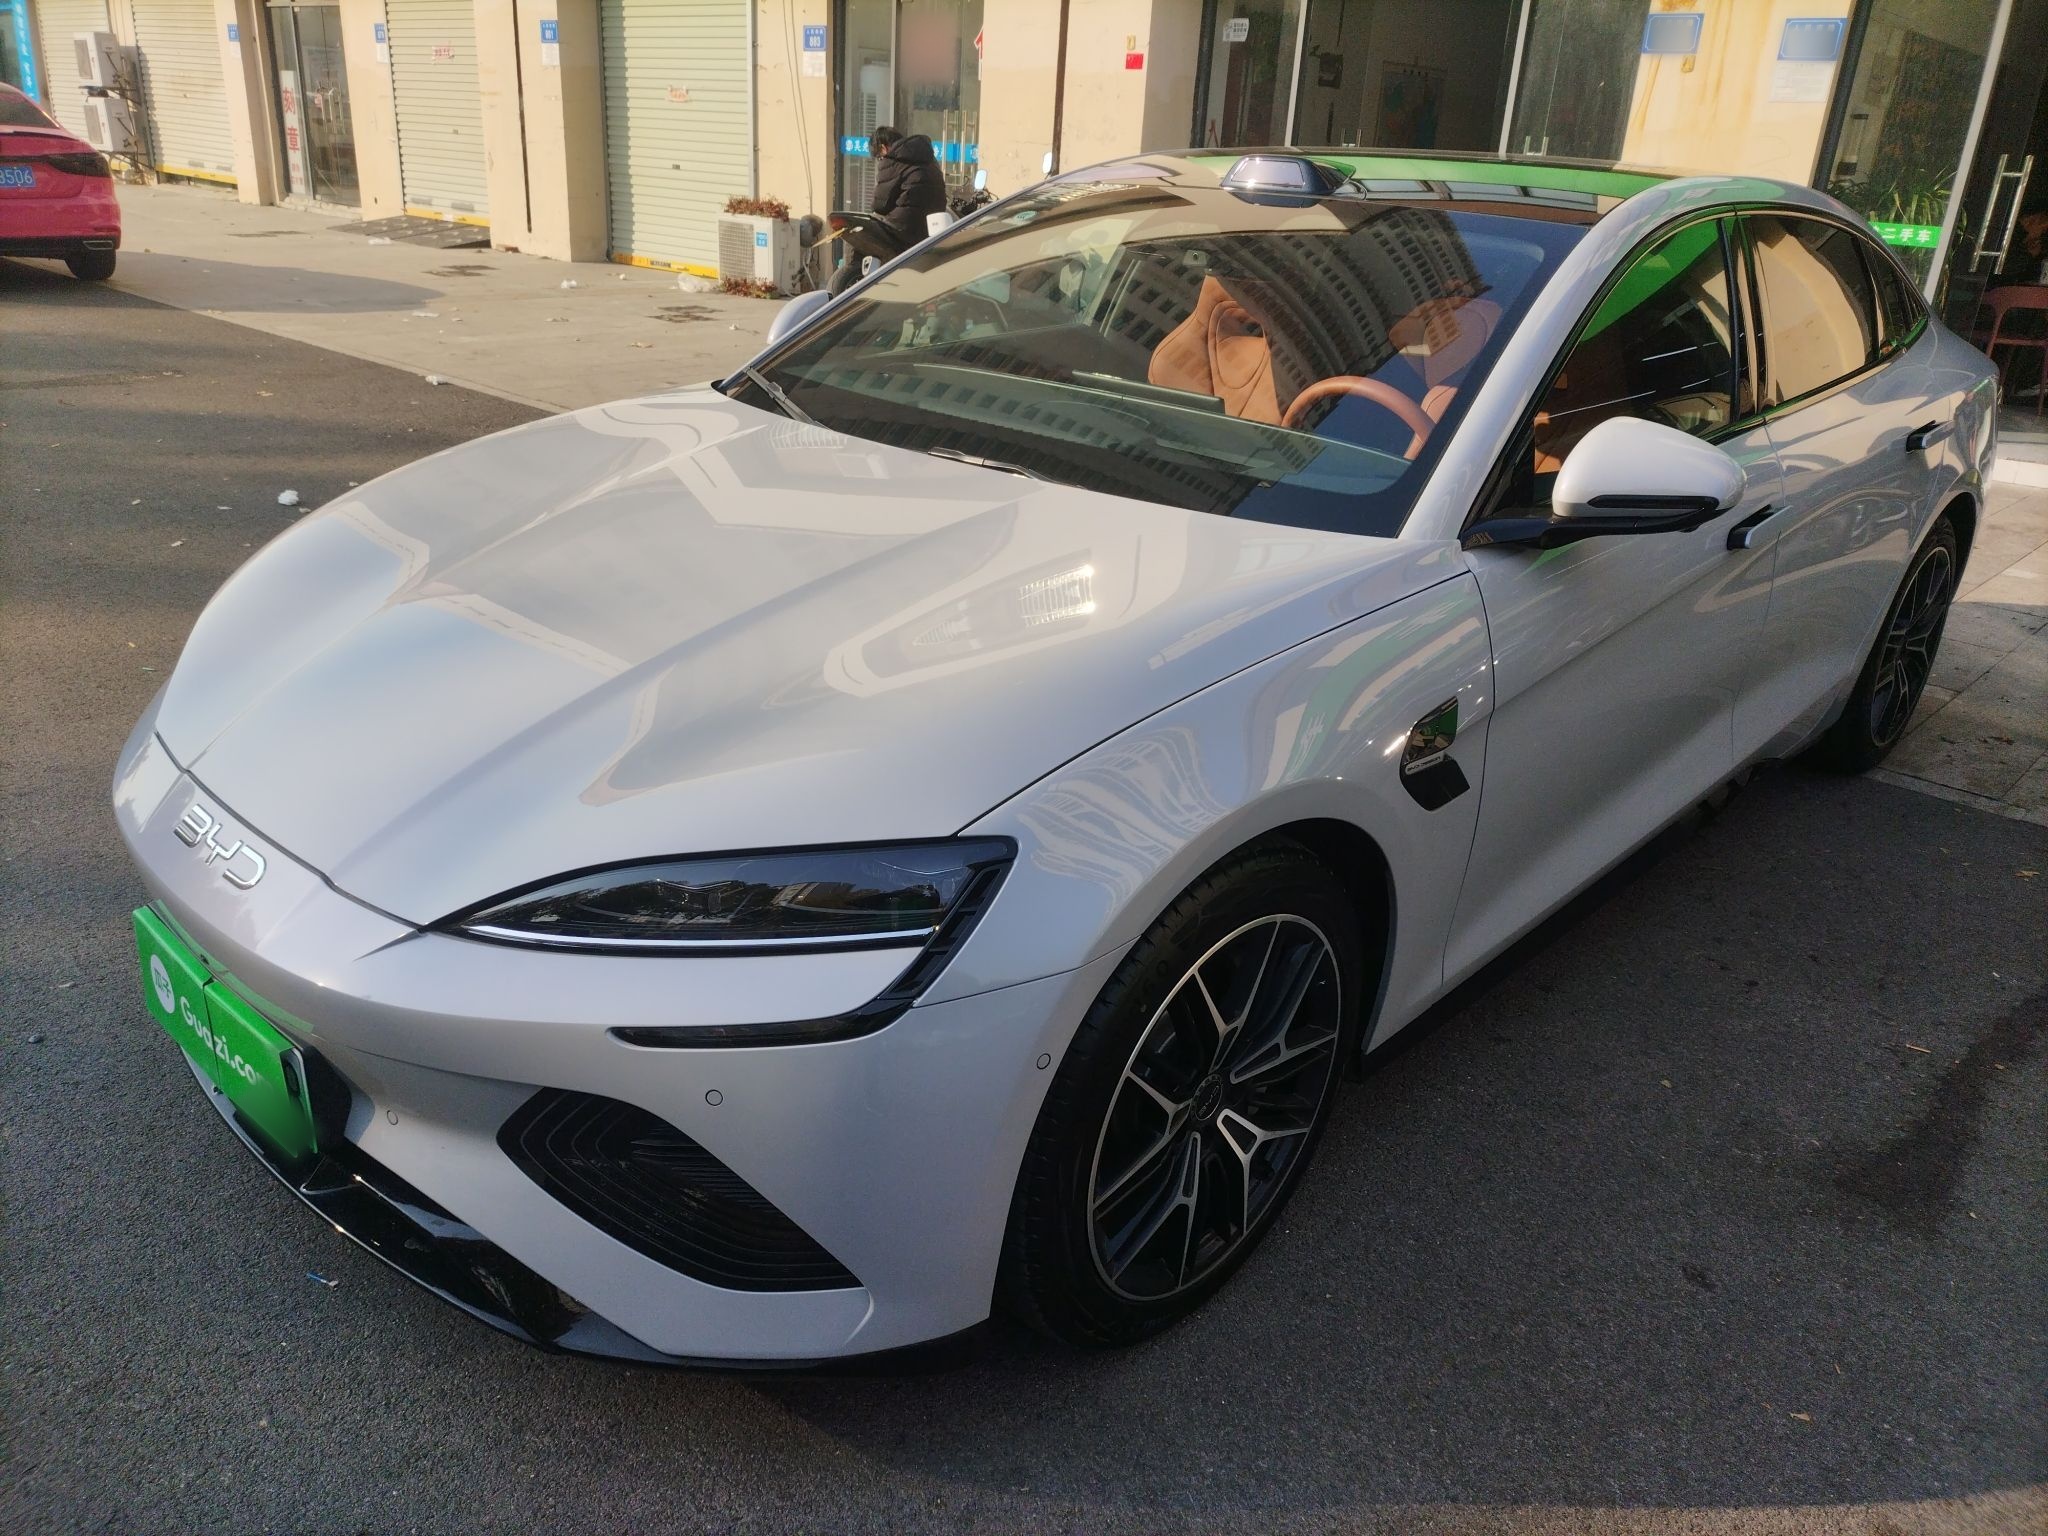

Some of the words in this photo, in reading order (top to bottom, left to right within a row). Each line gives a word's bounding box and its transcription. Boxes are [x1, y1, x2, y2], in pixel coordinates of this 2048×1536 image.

[282, 86, 300, 153] 刻章
[173, 803, 267, 890] BYD
[153, 967, 172, 999] 瓜子
[180, 996, 263, 1086] Guazi.co
